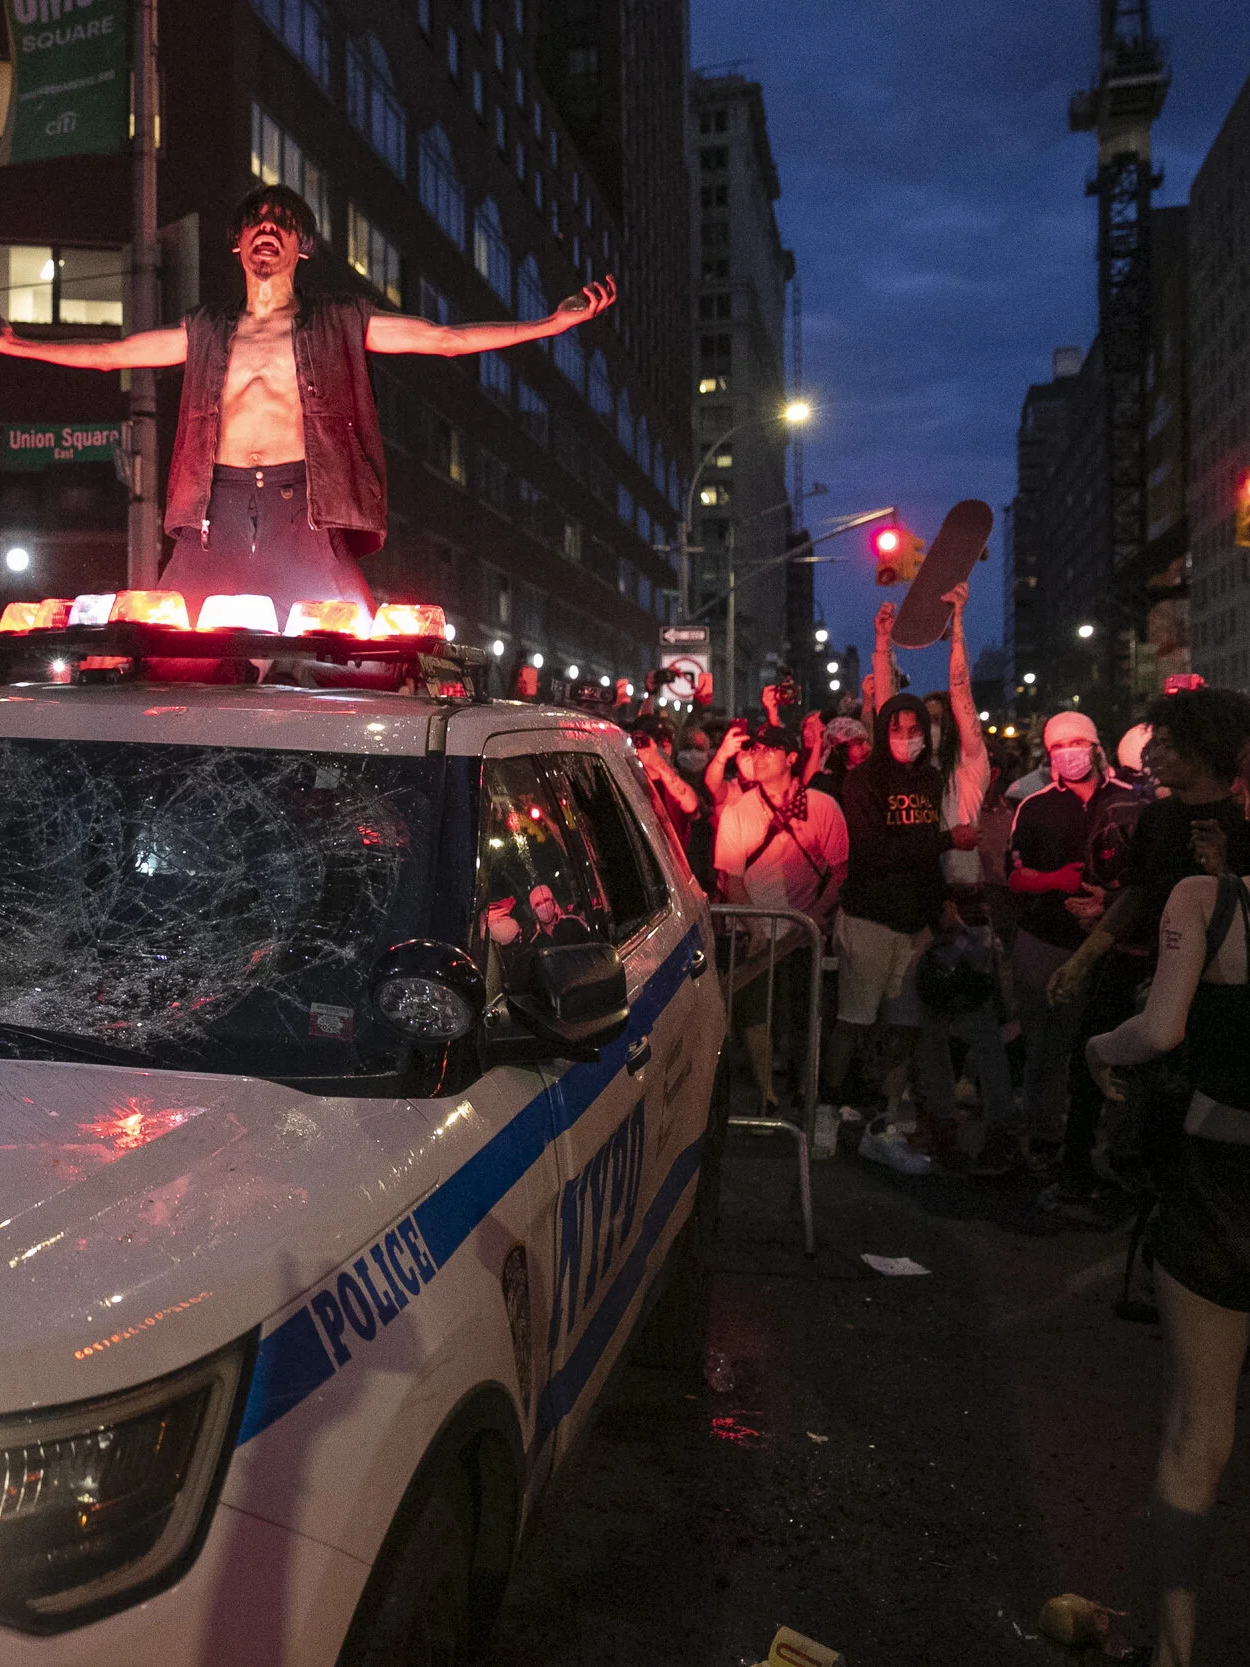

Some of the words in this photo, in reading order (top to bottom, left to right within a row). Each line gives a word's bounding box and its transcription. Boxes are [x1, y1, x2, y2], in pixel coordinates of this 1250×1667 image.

[22, 15, 115, 53] SQUARE
[9, 429, 55, 449] Union
[61, 427, 119, 451] Square
[547, 1098, 645, 1353] NYPD
[311, 1215, 437, 1369] POLICE
